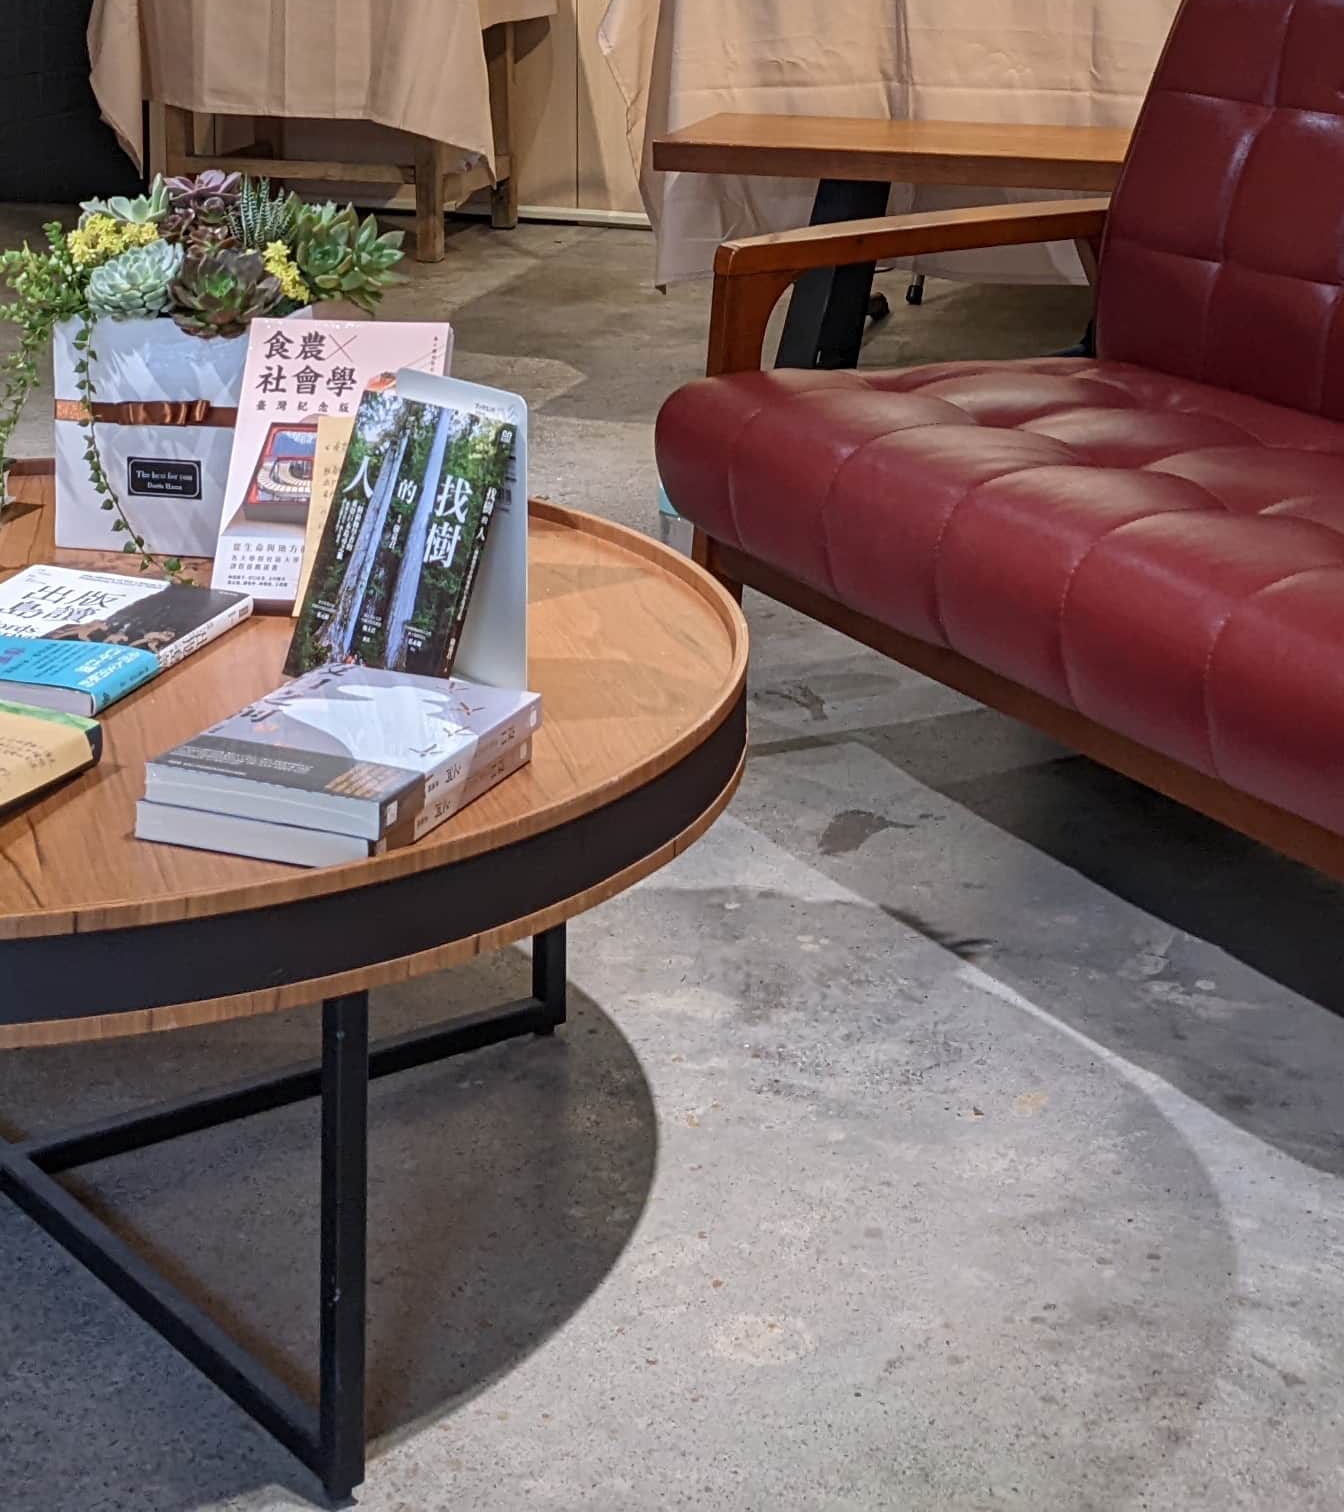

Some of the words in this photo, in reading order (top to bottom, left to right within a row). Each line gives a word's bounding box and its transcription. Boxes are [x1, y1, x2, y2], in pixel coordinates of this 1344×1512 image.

[255, 364, 358, 398] 社會學
[256, 400, 350, 414] 臺灣紀念版
[342, 455, 374, 499] 人
[396, 478, 418, 505] 的
[423, 474, 473, 569] 找樹
[21, 584, 127, 609] 出版
